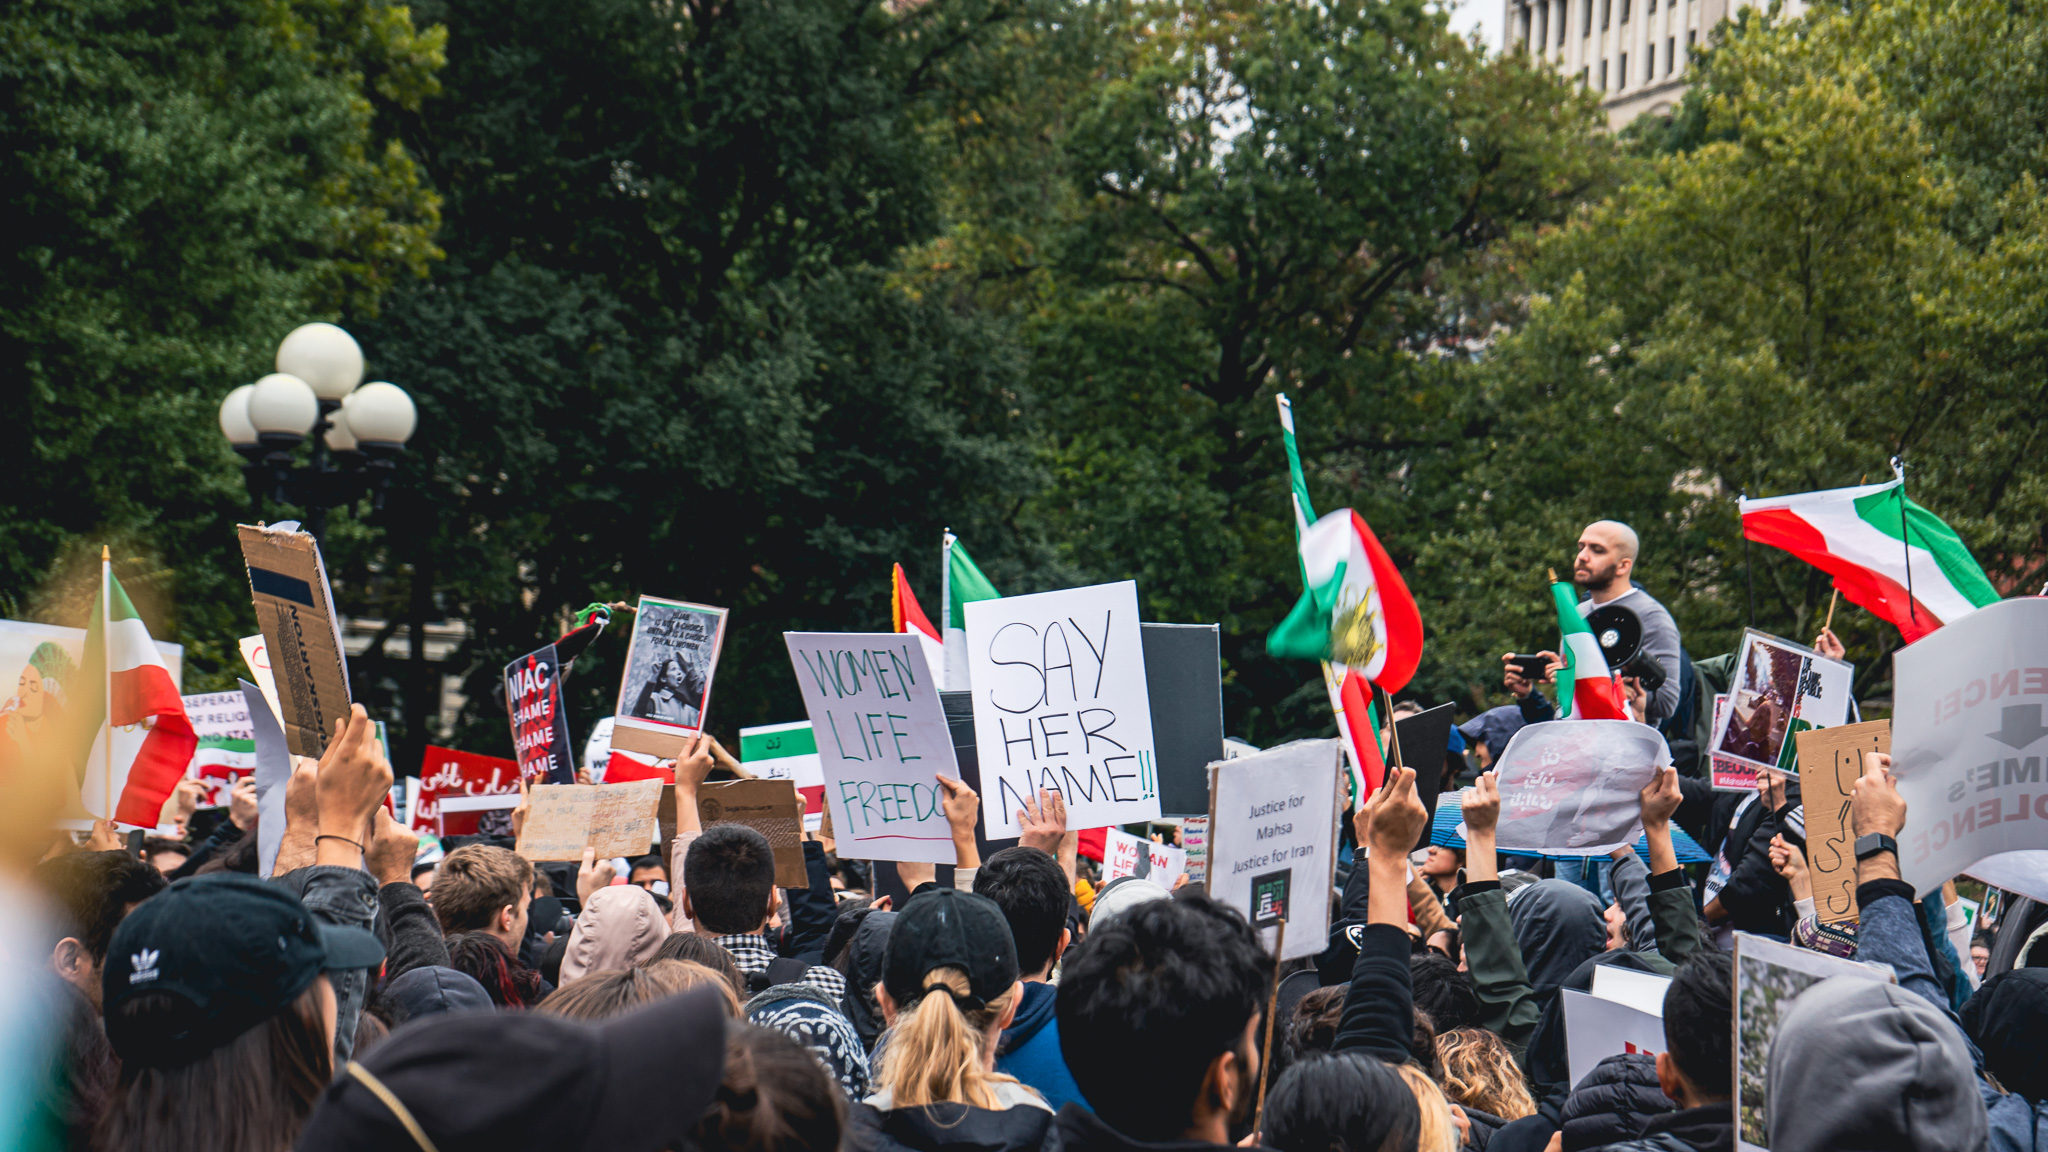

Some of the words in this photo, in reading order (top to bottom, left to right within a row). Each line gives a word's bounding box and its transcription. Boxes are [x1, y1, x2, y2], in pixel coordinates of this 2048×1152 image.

[799, 645, 916, 702] WOMEN
[989, 609, 1112, 714] SAY
[509, 662, 550, 703] NIAC
[184, 694, 244, 708] SEPERAT
[513, 698, 551, 728] SHAME
[225, 729, 255, 742] STAT
[827, 710, 921, 763] LIFE
[999, 707, 1127, 766] HER
[521, 753, 559, 779] HAME
[839, 780, 948, 834] FREEDO
[1249, 800, 1285, 820] Justice
[1288, 795, 1305, 809] for
[1256, 822, 1293, 841] Mahsa
[1117, 841, 1168, 868] WOAN
[1232, 855, 1269, 874] Justice
[1272, 849, 1288, 863] for
[1291, 845, 1314, 860] Iran
